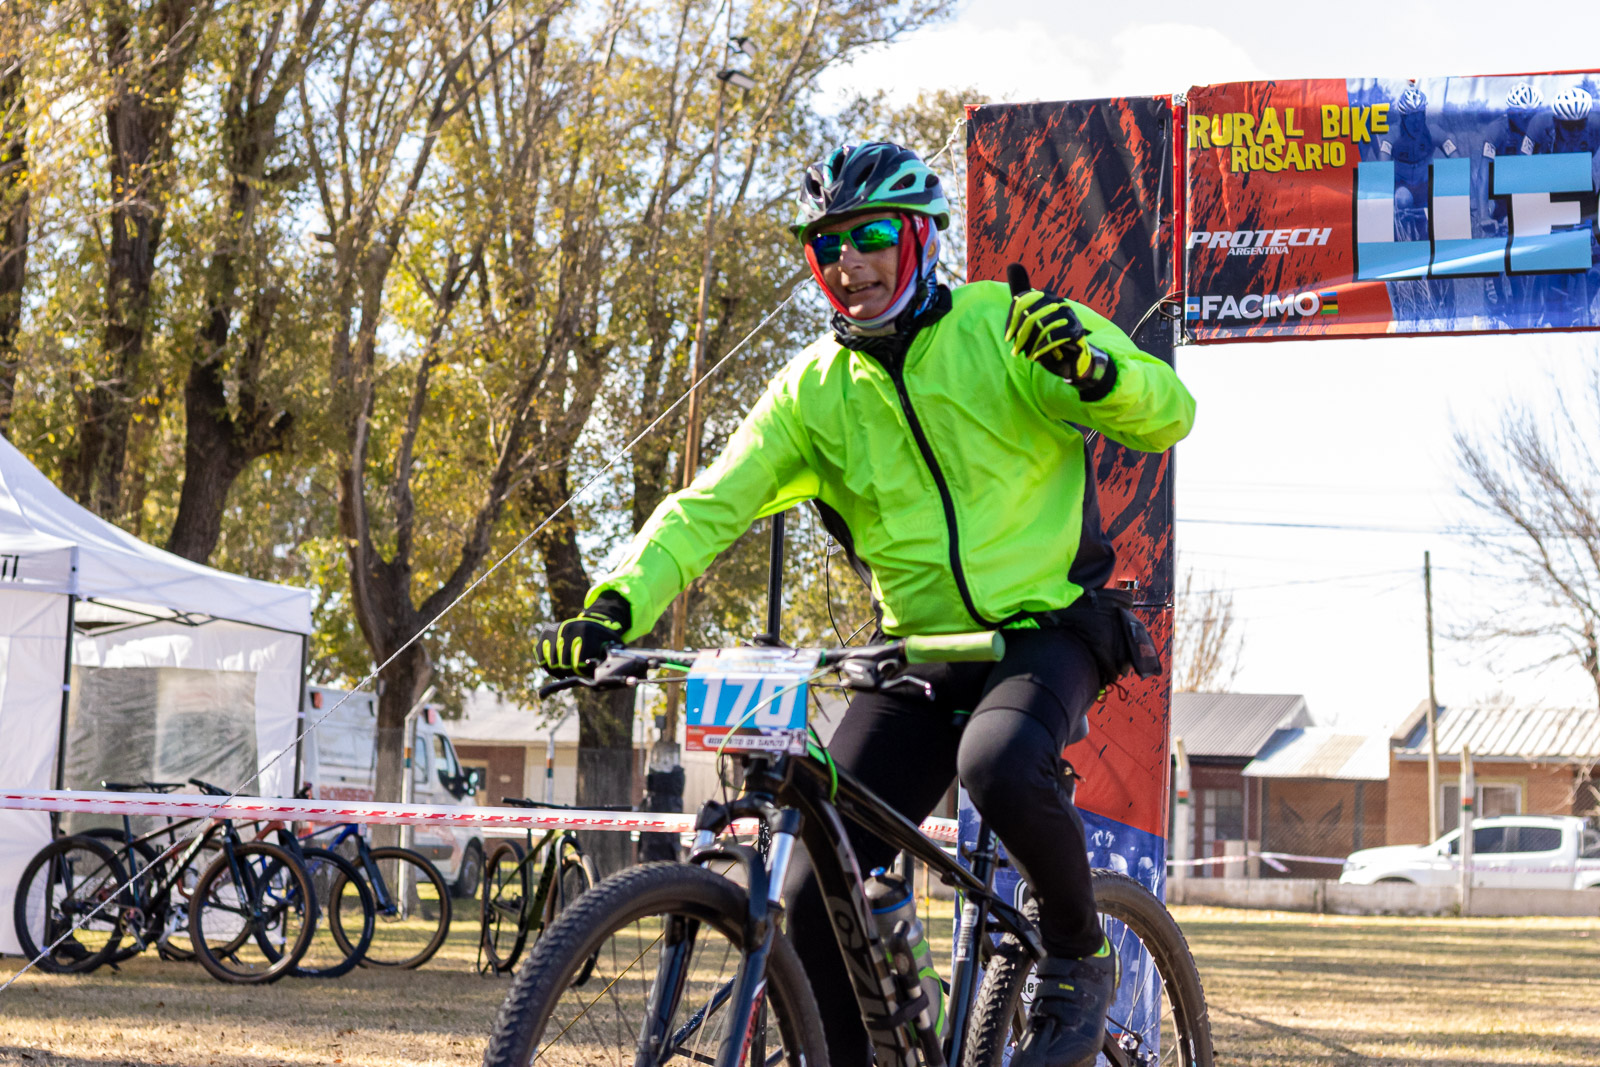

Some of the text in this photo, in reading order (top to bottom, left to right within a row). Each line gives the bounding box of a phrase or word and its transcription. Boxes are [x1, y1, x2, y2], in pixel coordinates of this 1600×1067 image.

[1189, 103, 1390, 148] RURAL BIKE
[1231, 141, 1346, 173] ROSARIO
[1353, 151, 1600, 281] LLE
[1186, 228, 1332, 249] PROTECH
[1227, 246, 1289, 256] ARGENTINA
[1202, 291, 1320, 320] FACIMO
[700, 673, 801, 726] 170
